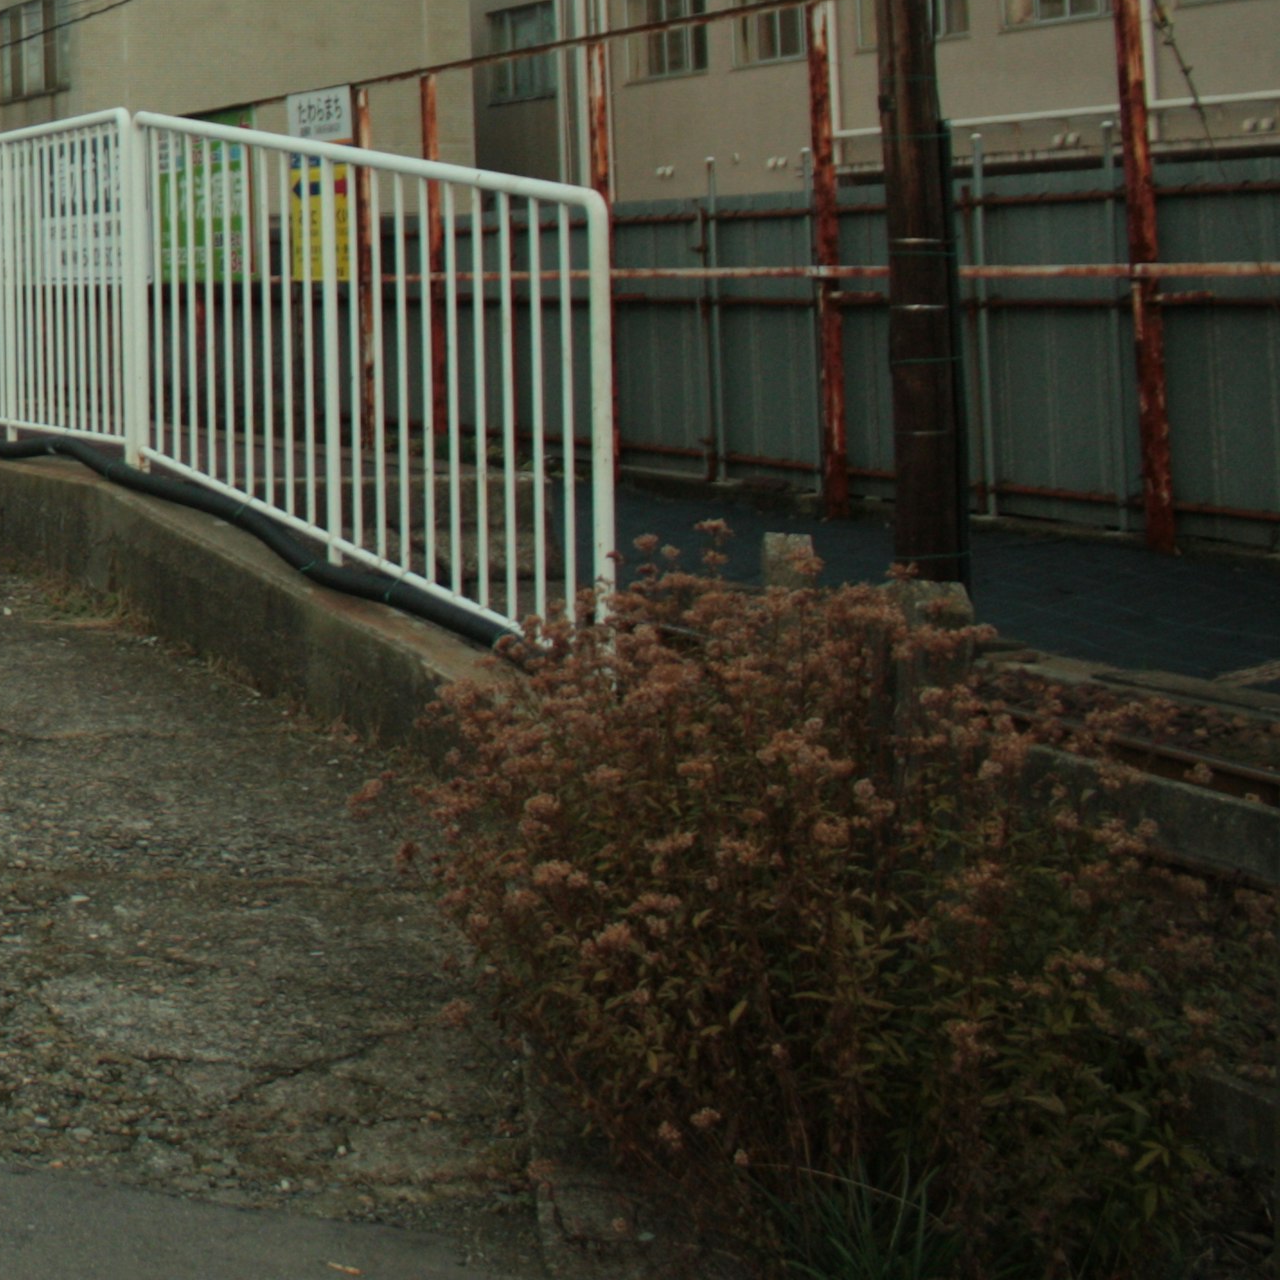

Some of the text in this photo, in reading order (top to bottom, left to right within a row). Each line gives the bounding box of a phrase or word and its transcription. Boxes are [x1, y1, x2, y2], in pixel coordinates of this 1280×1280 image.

[297, 94, 343, 124] たわらまち
